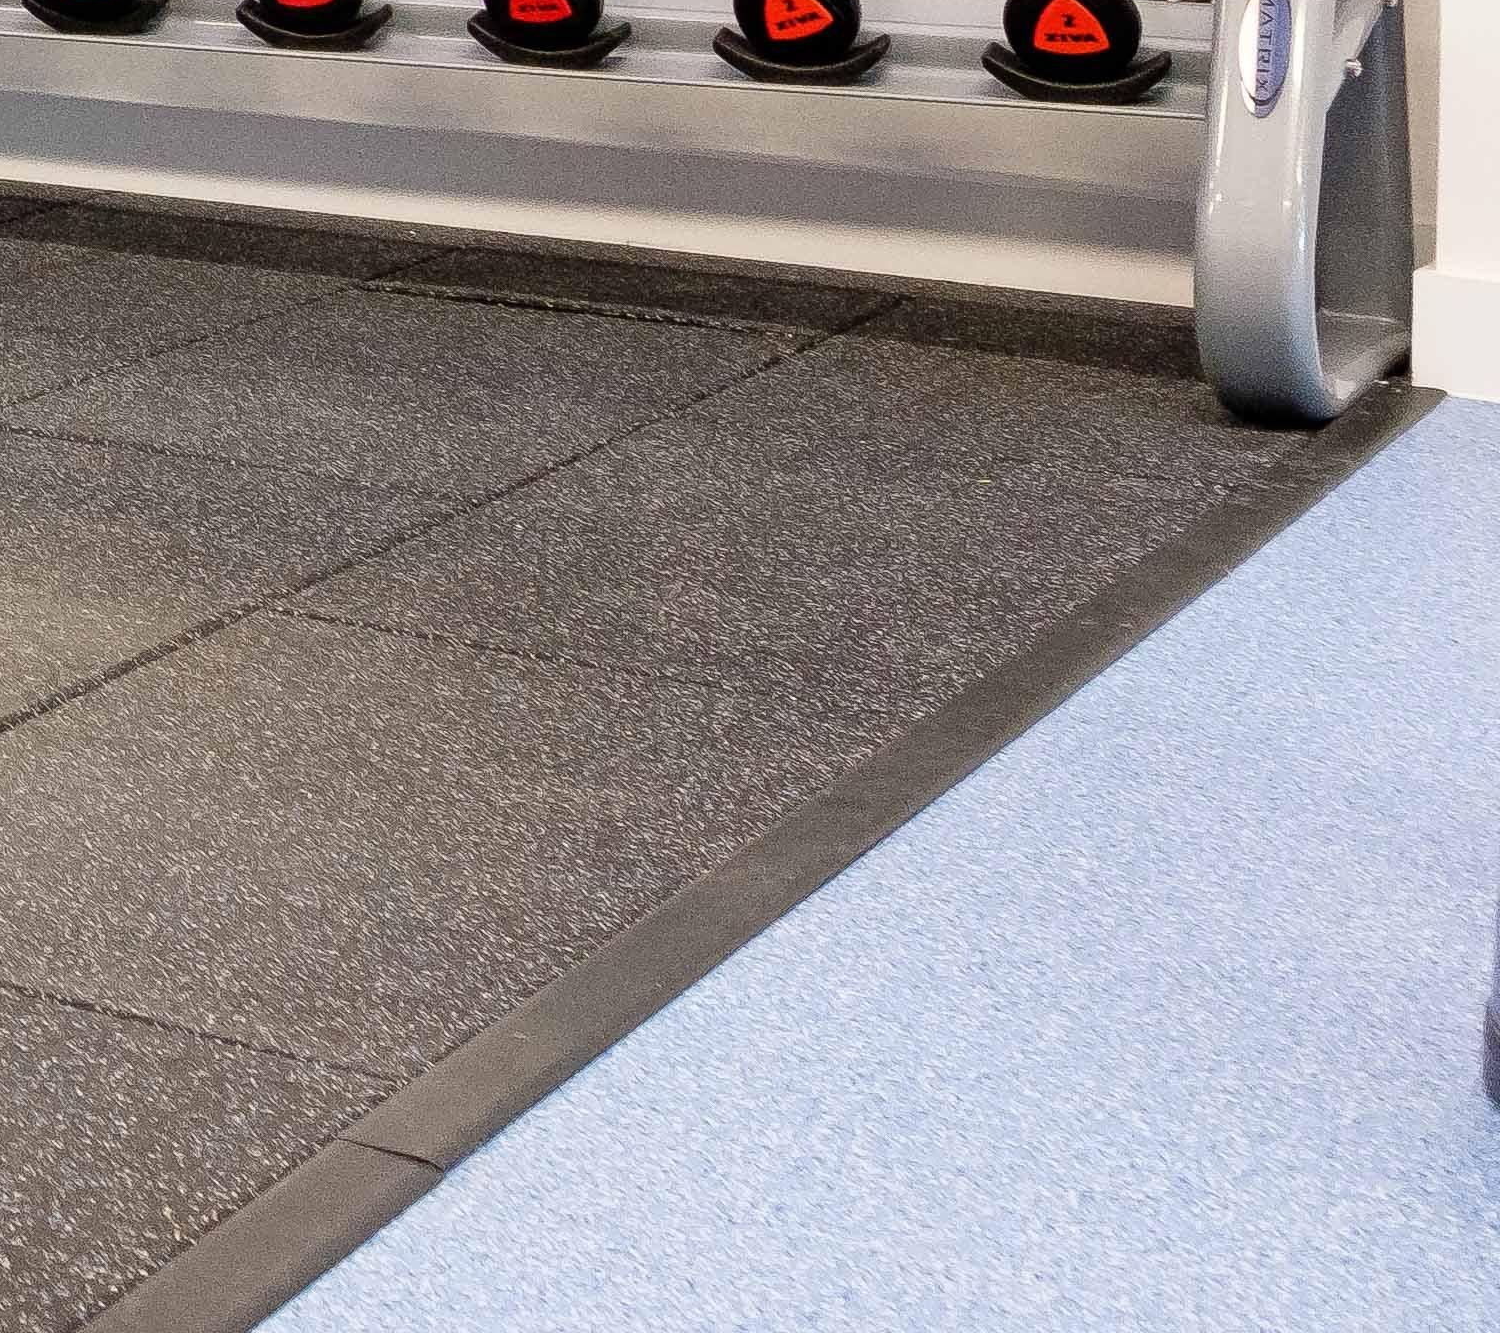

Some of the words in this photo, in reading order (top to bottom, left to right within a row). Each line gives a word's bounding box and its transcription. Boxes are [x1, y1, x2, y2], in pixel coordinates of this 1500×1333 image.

[776, 11, 819, 31] ZIVA
[1062, 13, 1074, 27] 2
[1044, 32, 1098, 42] ZIVA
